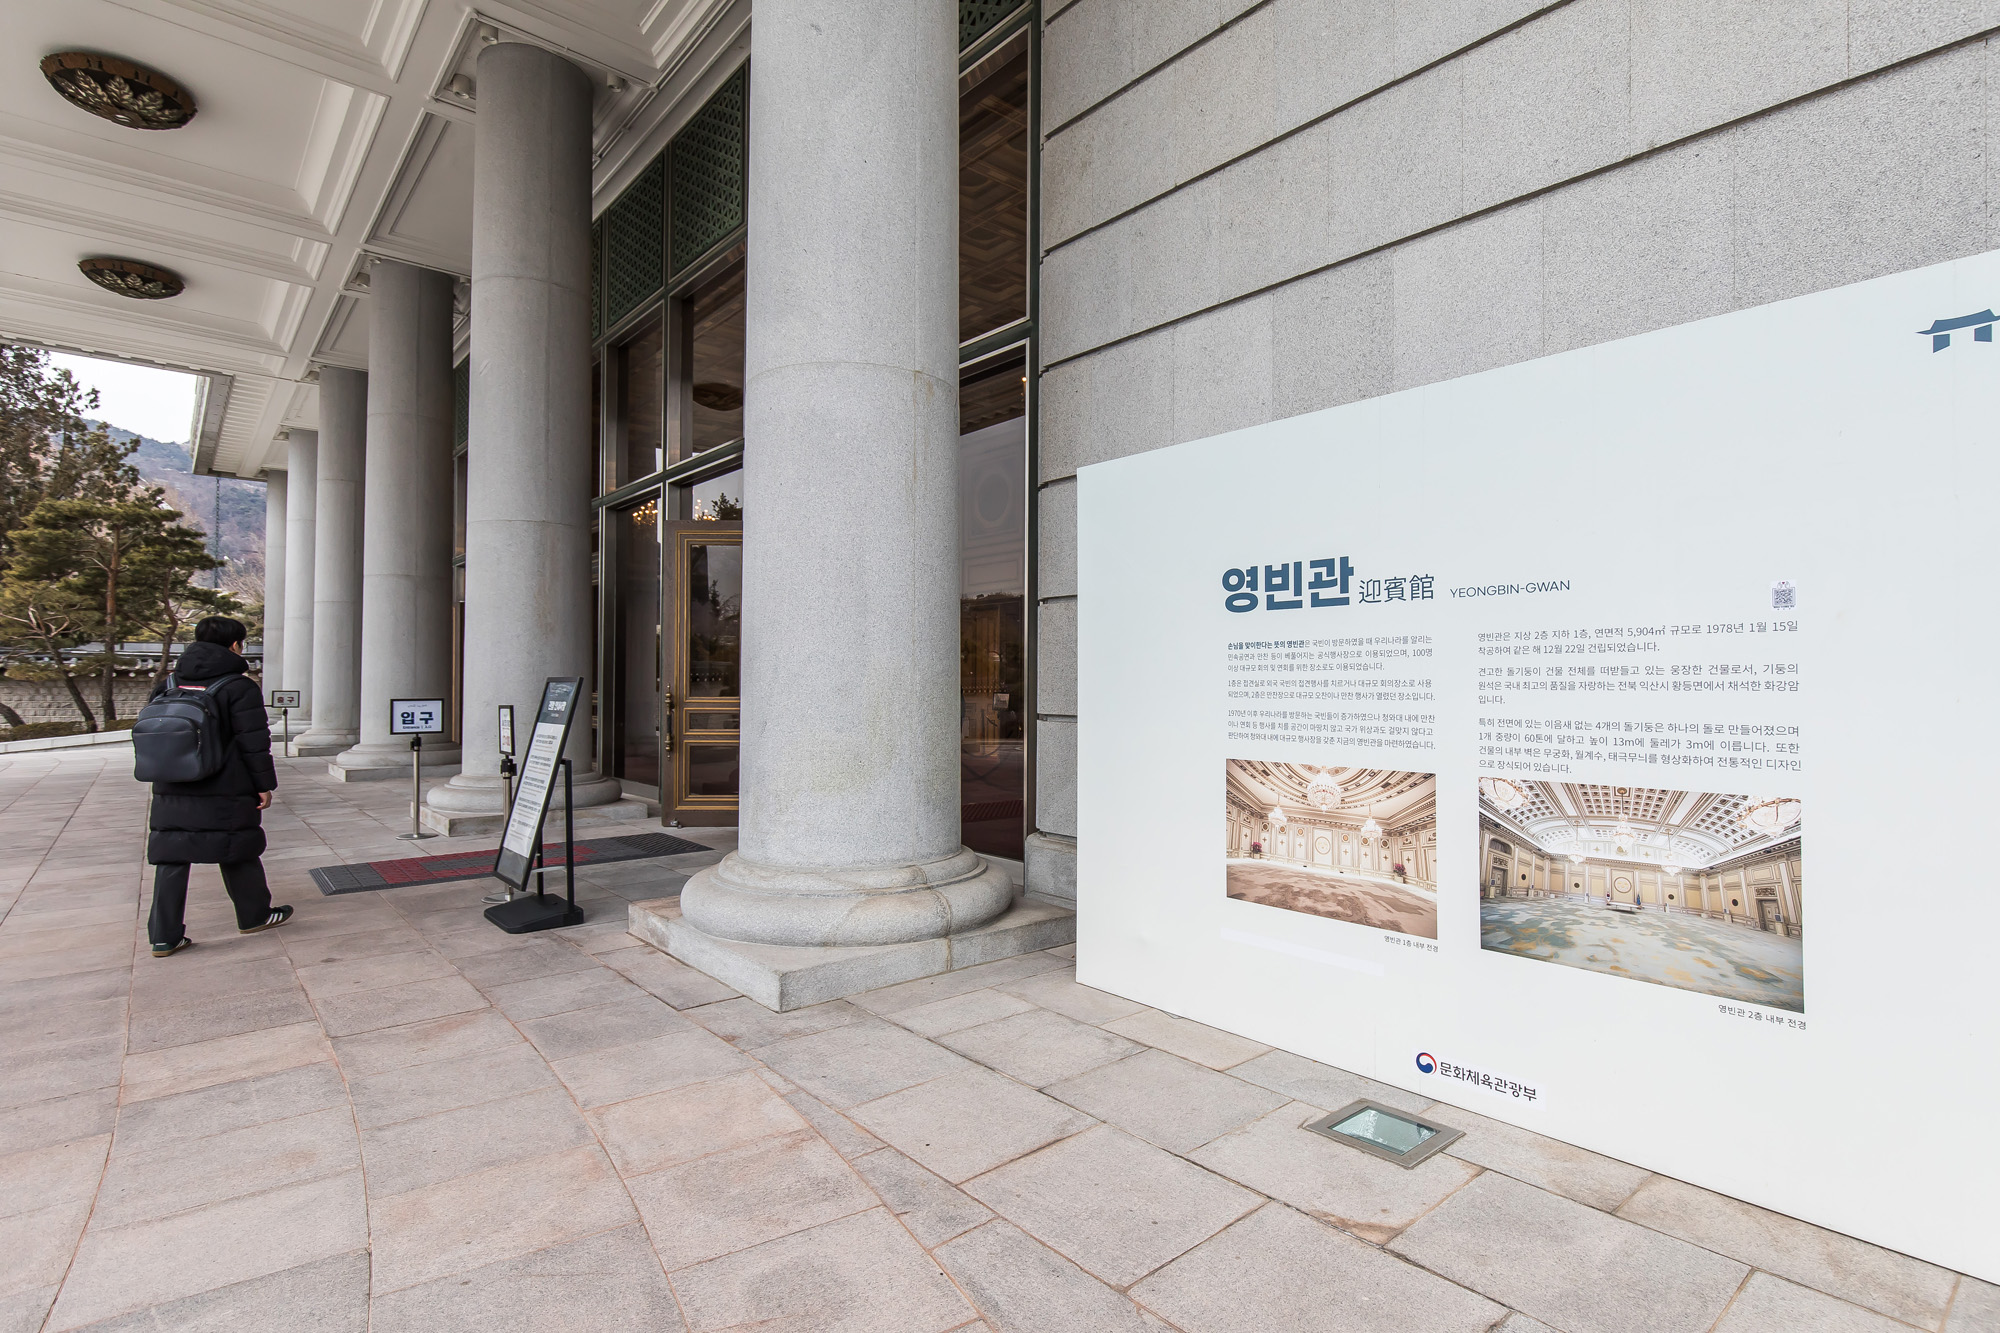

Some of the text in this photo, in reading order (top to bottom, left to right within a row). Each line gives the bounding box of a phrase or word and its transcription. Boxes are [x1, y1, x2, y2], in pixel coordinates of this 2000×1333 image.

[1222, 556, 1354, 613] 영빈관
[1358, 574, 1434, 604] 迎賓館
[1450, 580, 1570, 598] YEONGBIN-GWAN
[1478, 632, 1510, 642] 영빈관은
[1514, 631, 1531, 640] 지상
[1534, 631, 1548, 640] 2층
[1552, 630, 1570, 639] 지하
[1574, 629, 1591, 639] 1층,
[1594, 628, 1623, 638] 연면적
[1670, 625, 1702, 635] 규모로
[1707, 623, 1743, 634] 1978년
[1750, 622, 1766, 632] 1월
[1773, 620, 1798, 631] 15일
[1478, 642, 1660, 655] 착공하여 같은 해 12월 22일 건립되었습니다.
[1478, 664, 1798, 676] 견고한 돌기둥이 건물 전체를 떠받들고 있는 웅장한 건물로서, 기둥의
[1478, 681, 1799, 691] 원석은 국내 최고의 품질을 자랑하는 전북 익산시 황등면에서 채석한 화강암
[1478, 695, 1505, 704] 입니다.
[1479, 718, 1798, 736] 특히 전면에 있는 이음새 없는 4개의 돌기둥은 하나의 돌로 만들어졌으며
[1479, 732, 1800, 754] 1개 중량이 60톤에 달하고 높이 13m에 둘레가 3m에 이릅니다. 또한
[1479, 746, 1502, 755] 건물의
[1505, 747, 1521, 756] 내부
[1544, 749, 1573, 760] 무궁화,
[1608, 752, 1658, 764] 태극무늬를
[1661, 754, 1713, 766] 형상화하여
[1717, 757, 1762, 769] 전통적인
[1766, 759, 1801, 771] 디자인
[1479, 760, 1572, 773] 으로 장식되어 있습니다.
[1718, 1004, 1806, 1030] 영빈관 2층 내부 전경
[1440, 1062, 1537, 1101] 문화체육관광부
